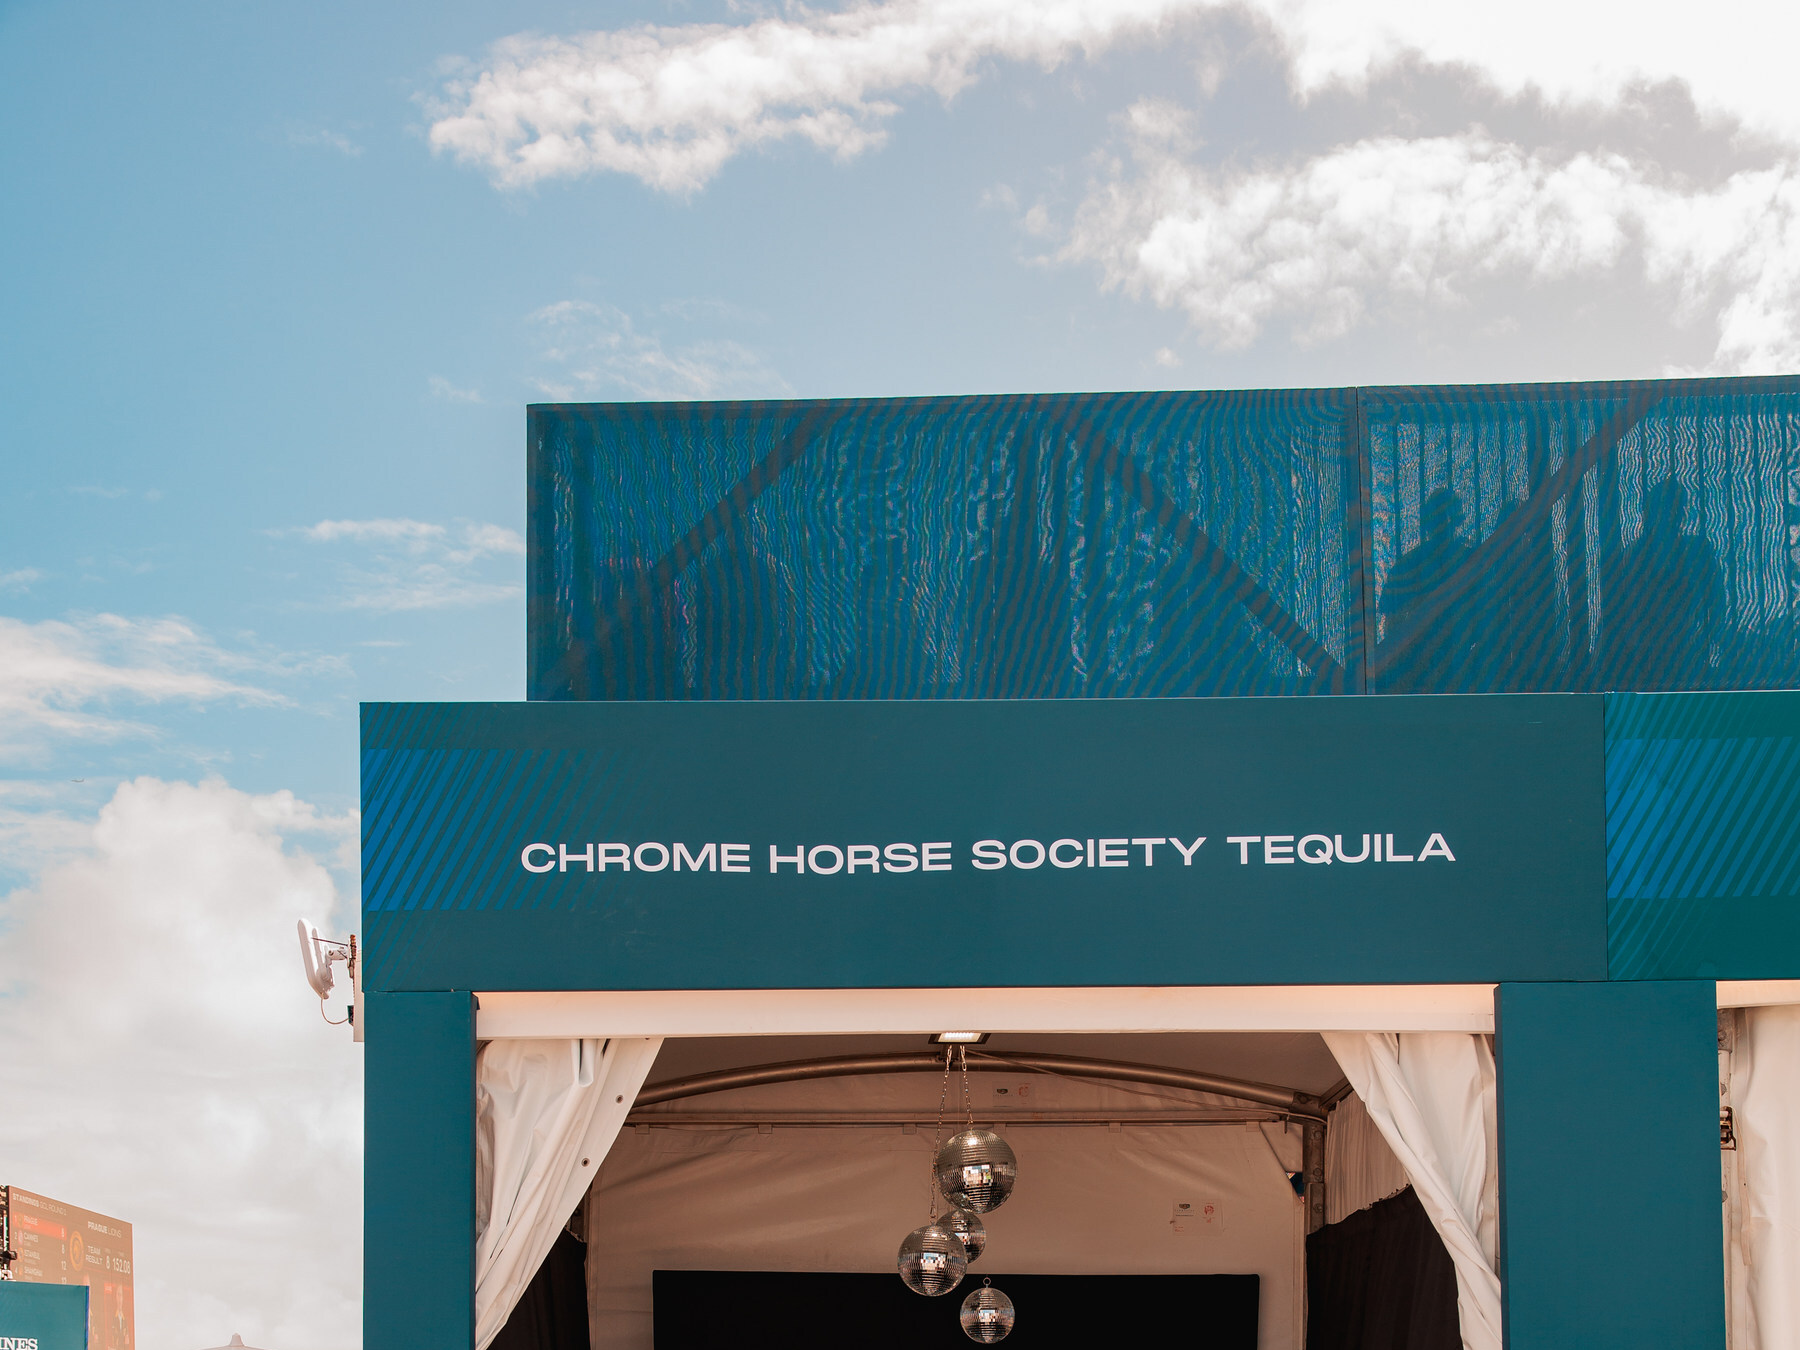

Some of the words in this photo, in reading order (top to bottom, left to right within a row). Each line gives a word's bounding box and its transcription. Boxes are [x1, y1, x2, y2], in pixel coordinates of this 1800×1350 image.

[521, 841, 751, 874] CHROME
[769, 841, 953, 875] HORSE
[971, 836, 1207, 871] SOCIETY
[1226, 832, 1456, 866] TEQUILA
